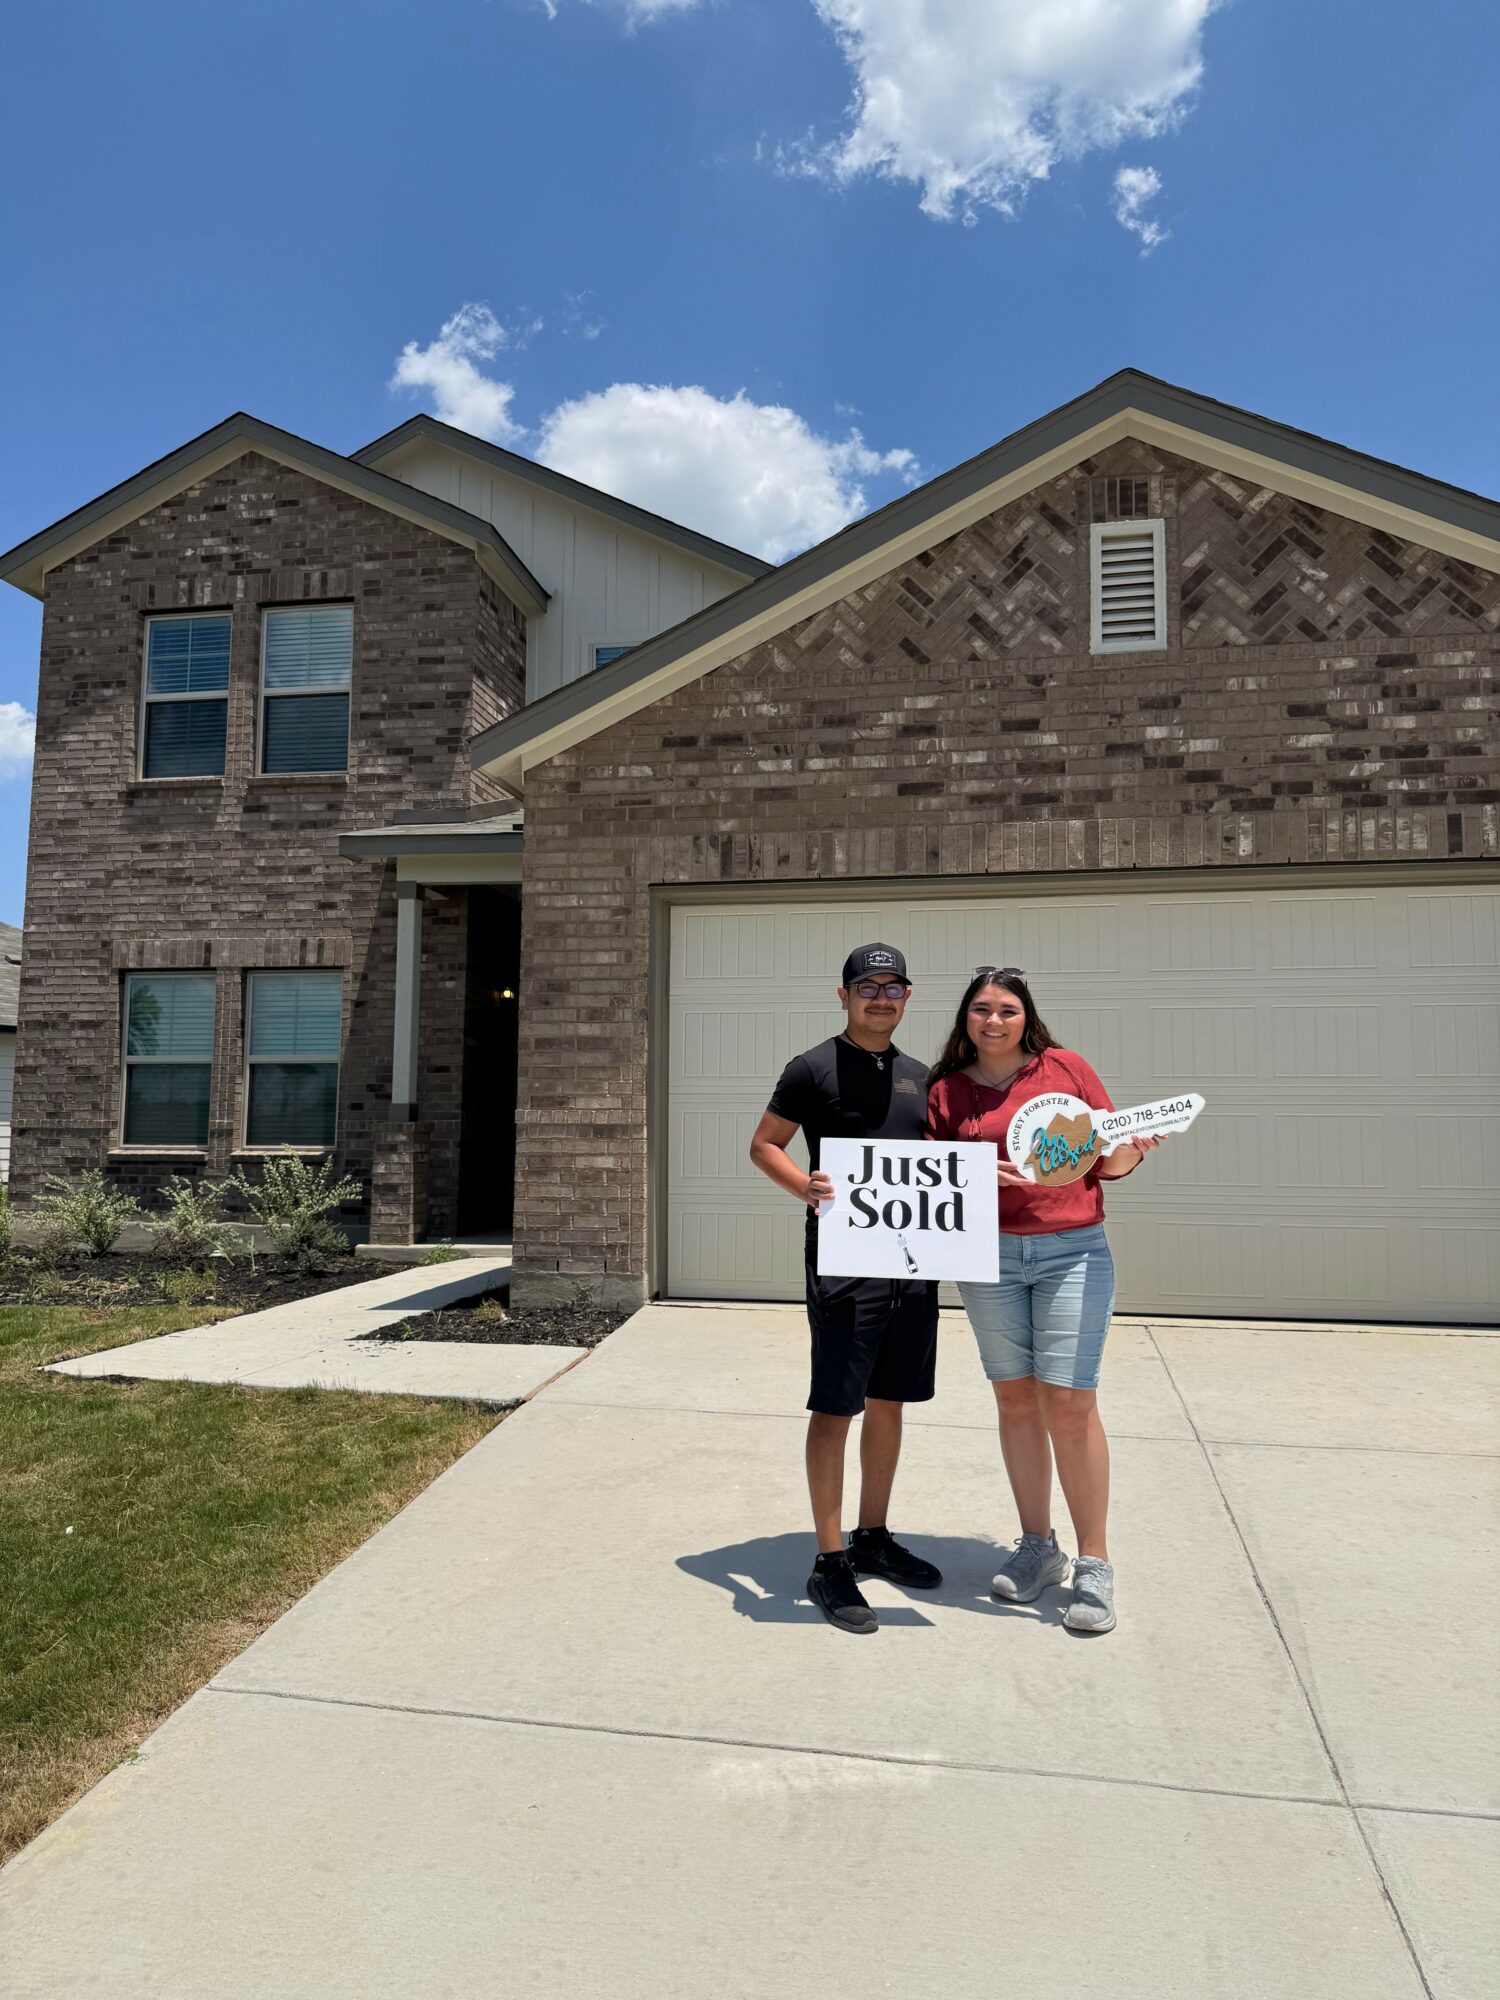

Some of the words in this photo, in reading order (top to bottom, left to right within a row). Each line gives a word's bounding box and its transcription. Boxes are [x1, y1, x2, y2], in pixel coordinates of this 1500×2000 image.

[1012, 1116, 1025, 1151] STACEY
[1023, 1097, 1070, 1117] FORESTER
[1102, 1115, 1131, 1130] (210)
[1133, 1099, 1192, 1123] 718-5404
[847, 1145, 968, 1188] Just
[848, 1187, 967, 1232] Sold
